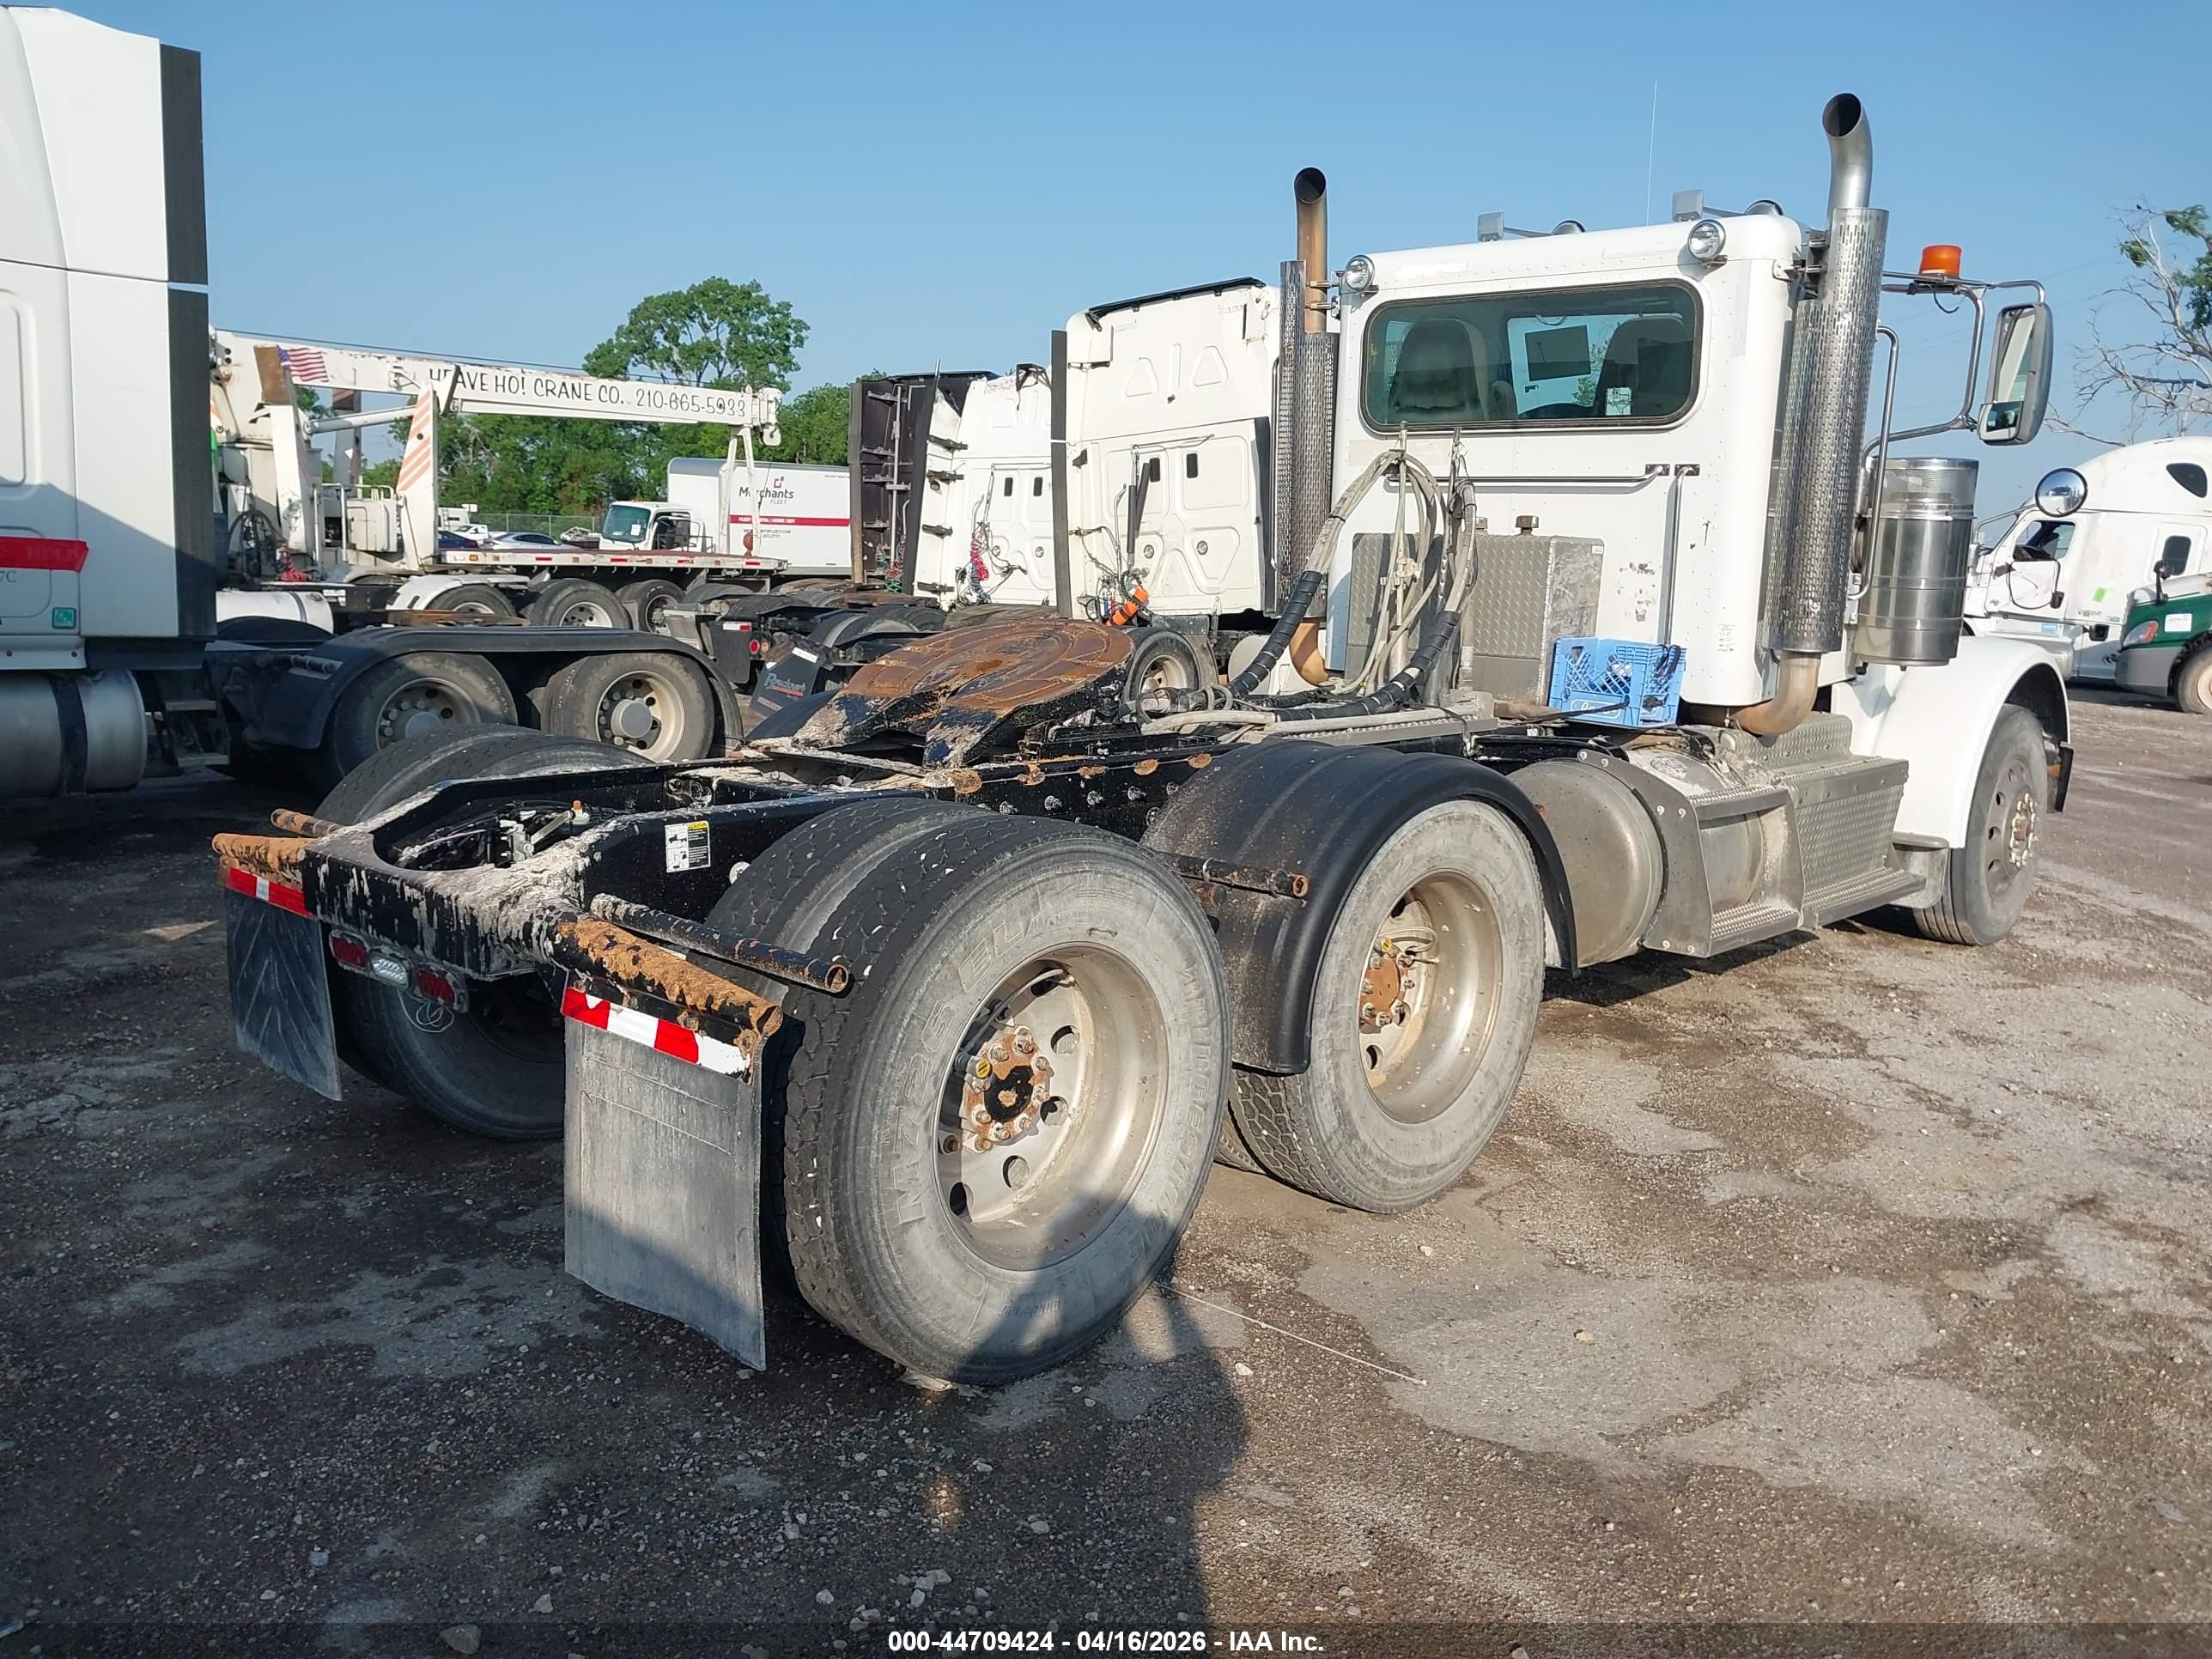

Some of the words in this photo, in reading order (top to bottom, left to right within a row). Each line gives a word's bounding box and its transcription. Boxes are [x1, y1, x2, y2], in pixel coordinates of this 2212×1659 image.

[495, 374, 526, 396] HO!
[533, 378, 593, 401] CRANE
[599, 385, 624, 404] CO.
[738, 486, 794, 499] Mrchants
